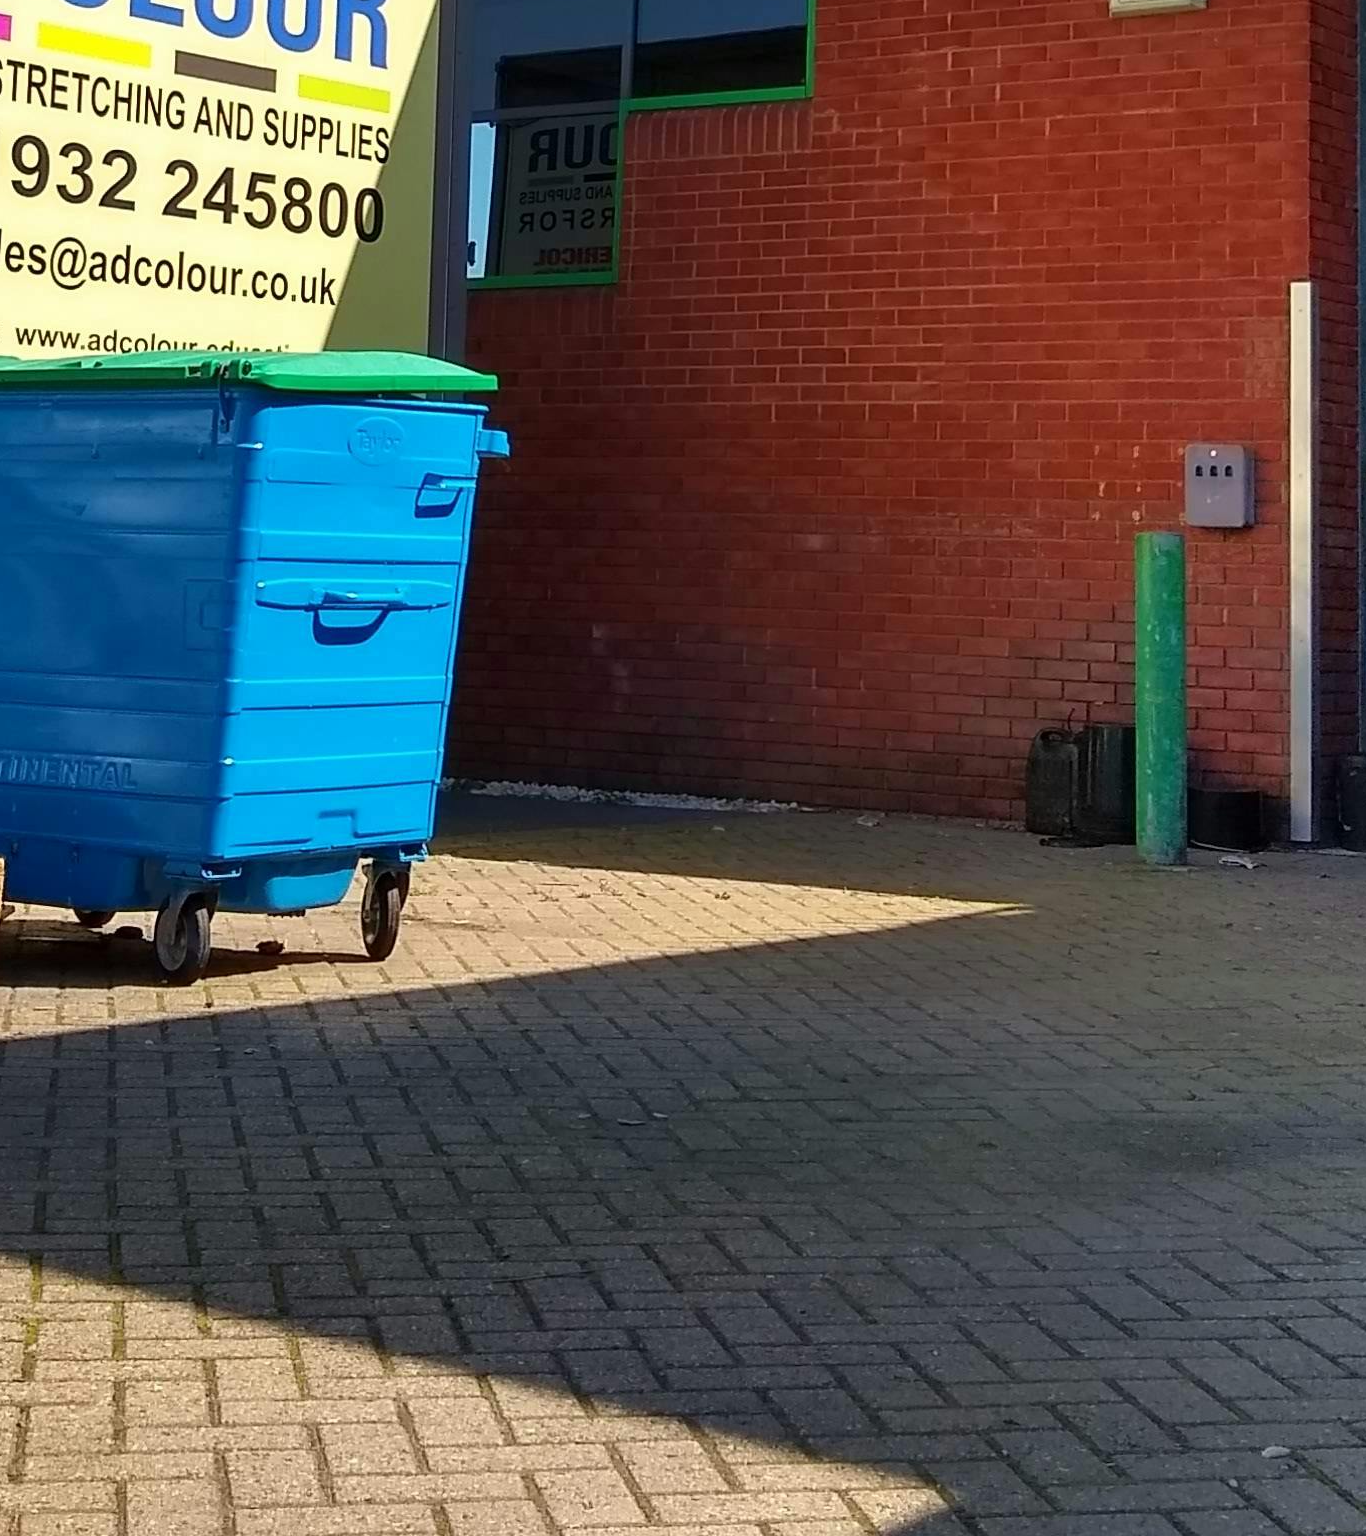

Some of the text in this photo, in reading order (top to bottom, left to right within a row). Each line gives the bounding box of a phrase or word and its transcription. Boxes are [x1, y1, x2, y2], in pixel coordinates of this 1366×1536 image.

[193, 96, 254, 141] AND
[262, 107, 391, 165] SUPPLIES
[161, 158, 385, 244] 245800
